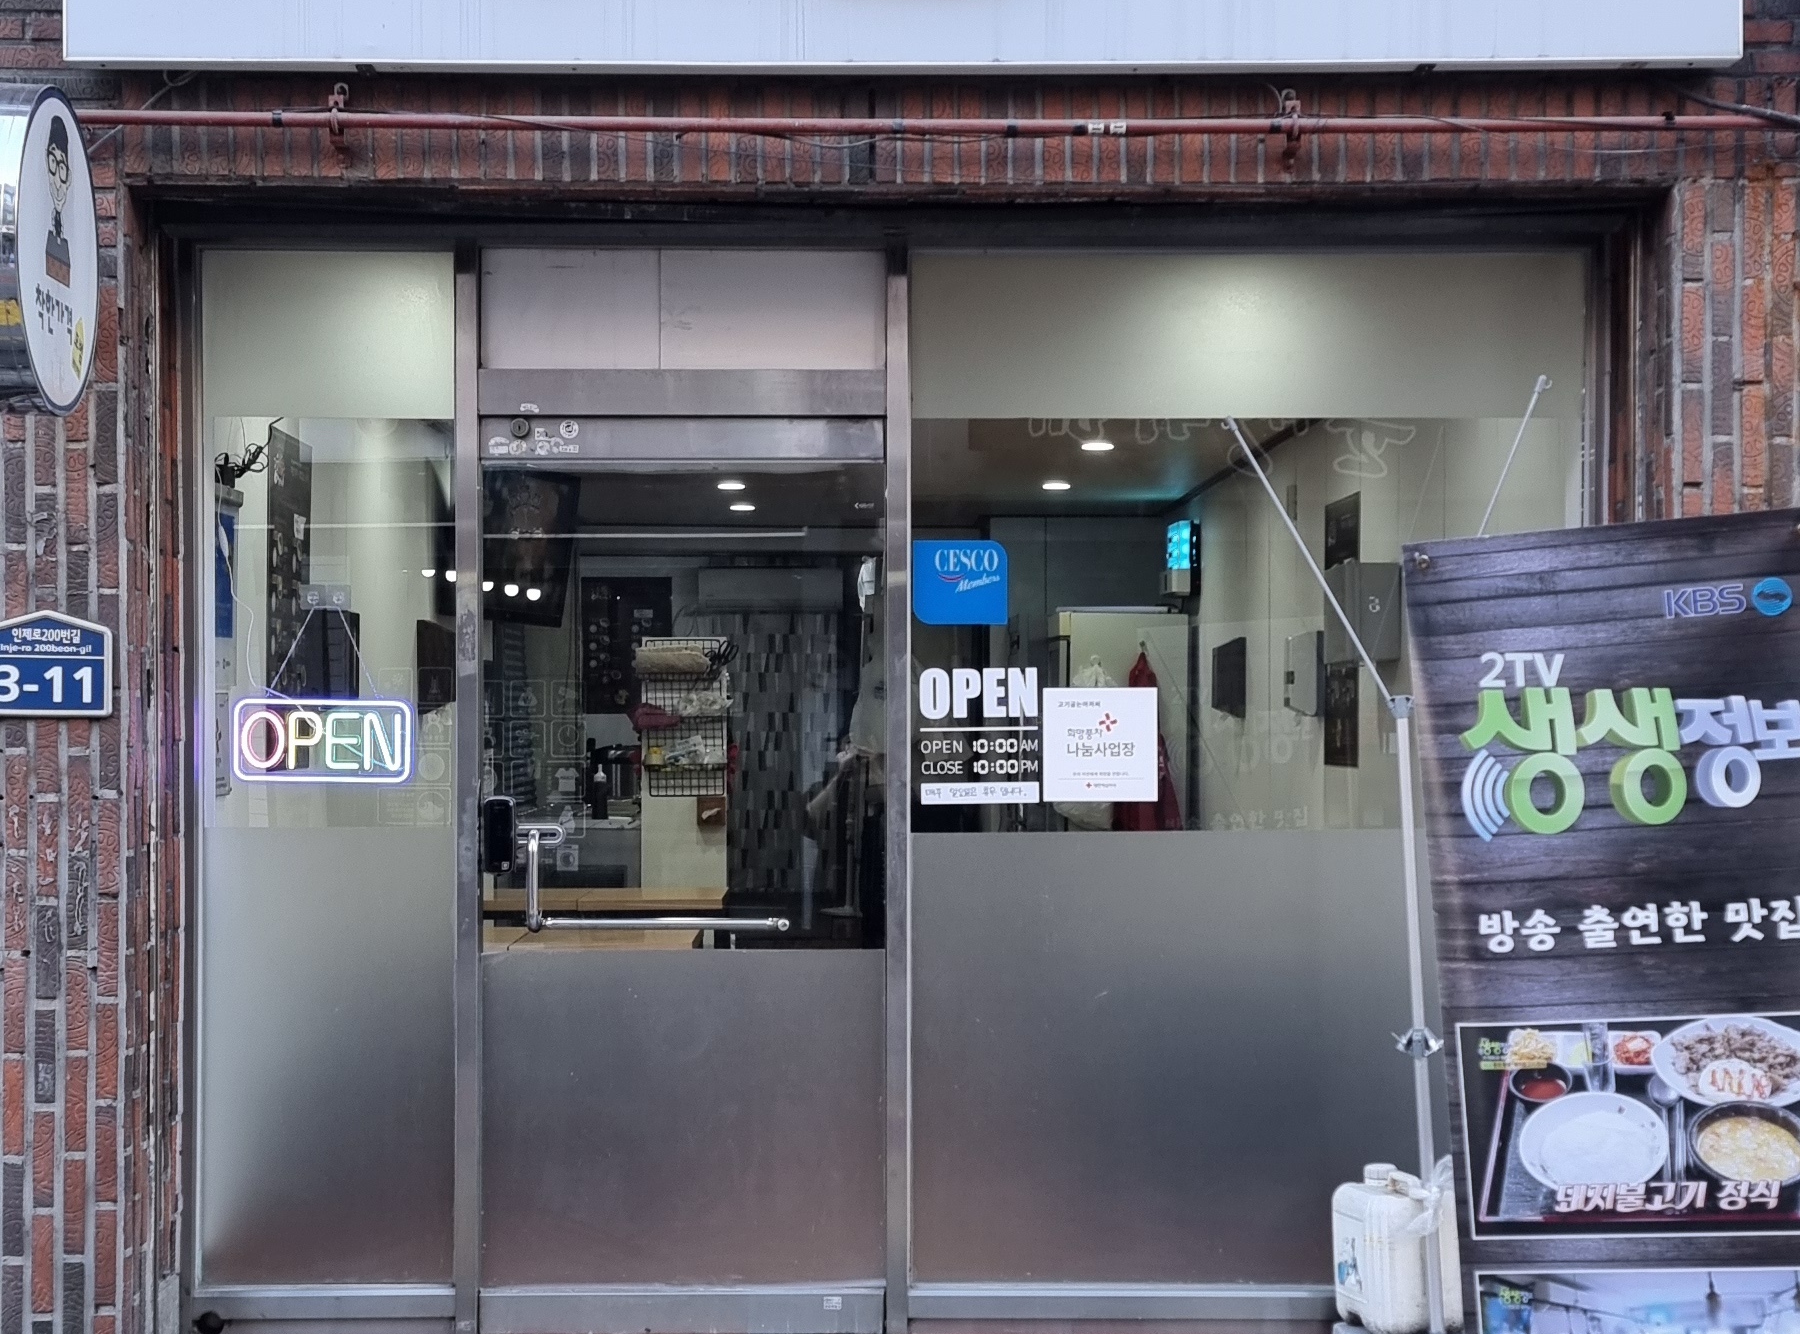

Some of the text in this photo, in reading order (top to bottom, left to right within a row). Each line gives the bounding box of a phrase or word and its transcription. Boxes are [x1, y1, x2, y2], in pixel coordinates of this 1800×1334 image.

[35, 282, 73, 346] 착한가격
[934, 548, 999, 572] CESCO
[954, 572, 1000, 594] Members
[1664, 583, 1747, 620] KBS
[11, 627, 81, 644] 인제로200번길
[34, 644, 92, 655] 200beon-gil
[1479, 651, 1566, 688] 2TV
[919, 667, 1039, 720] OPEN
[240, 709, 402, 772] OPEN
[1066, 727, 1104, 741] 희망풍차
[920, 738, 1039, 755] OPEN 10:00 AM
[1066, 741, 1136, 758] 나눔사업장
[921, 759, 1039, 775] CLOSE 10:00 PM
[1478, 895, 1800, 954] 방송 출연한 맛집
[1554, 1178, 1783, 1213] 돼지불고기 정식
